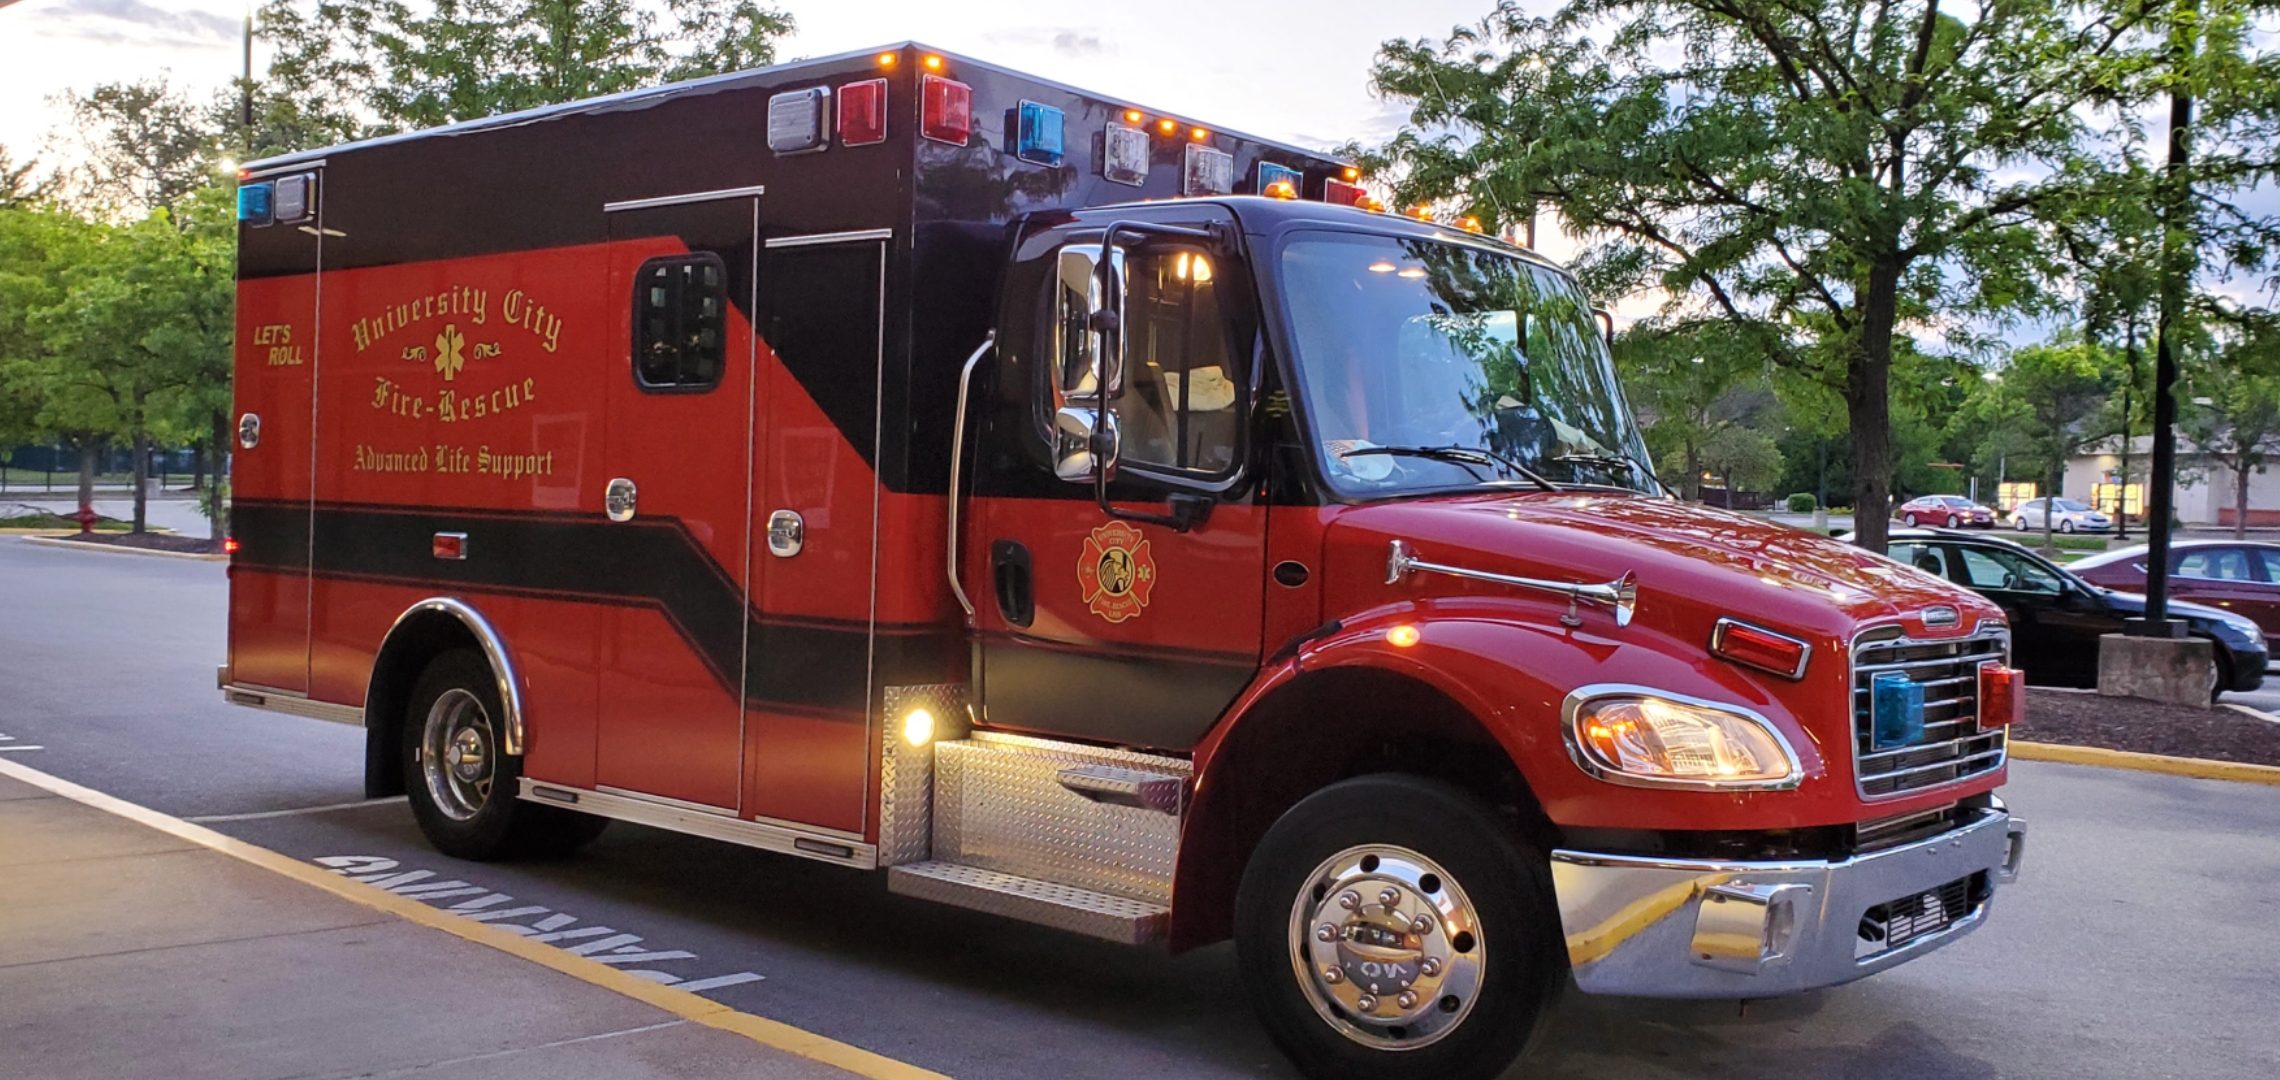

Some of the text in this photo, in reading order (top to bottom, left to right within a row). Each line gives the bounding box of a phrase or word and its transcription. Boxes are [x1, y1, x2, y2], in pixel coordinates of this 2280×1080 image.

[352, 285, 562, 353] University City
[268, 345, 303, 366] ROLL
[370, 376, 535, 422] Fire-Rescue
[353, 444, 553, 480] Advanced Life Support
